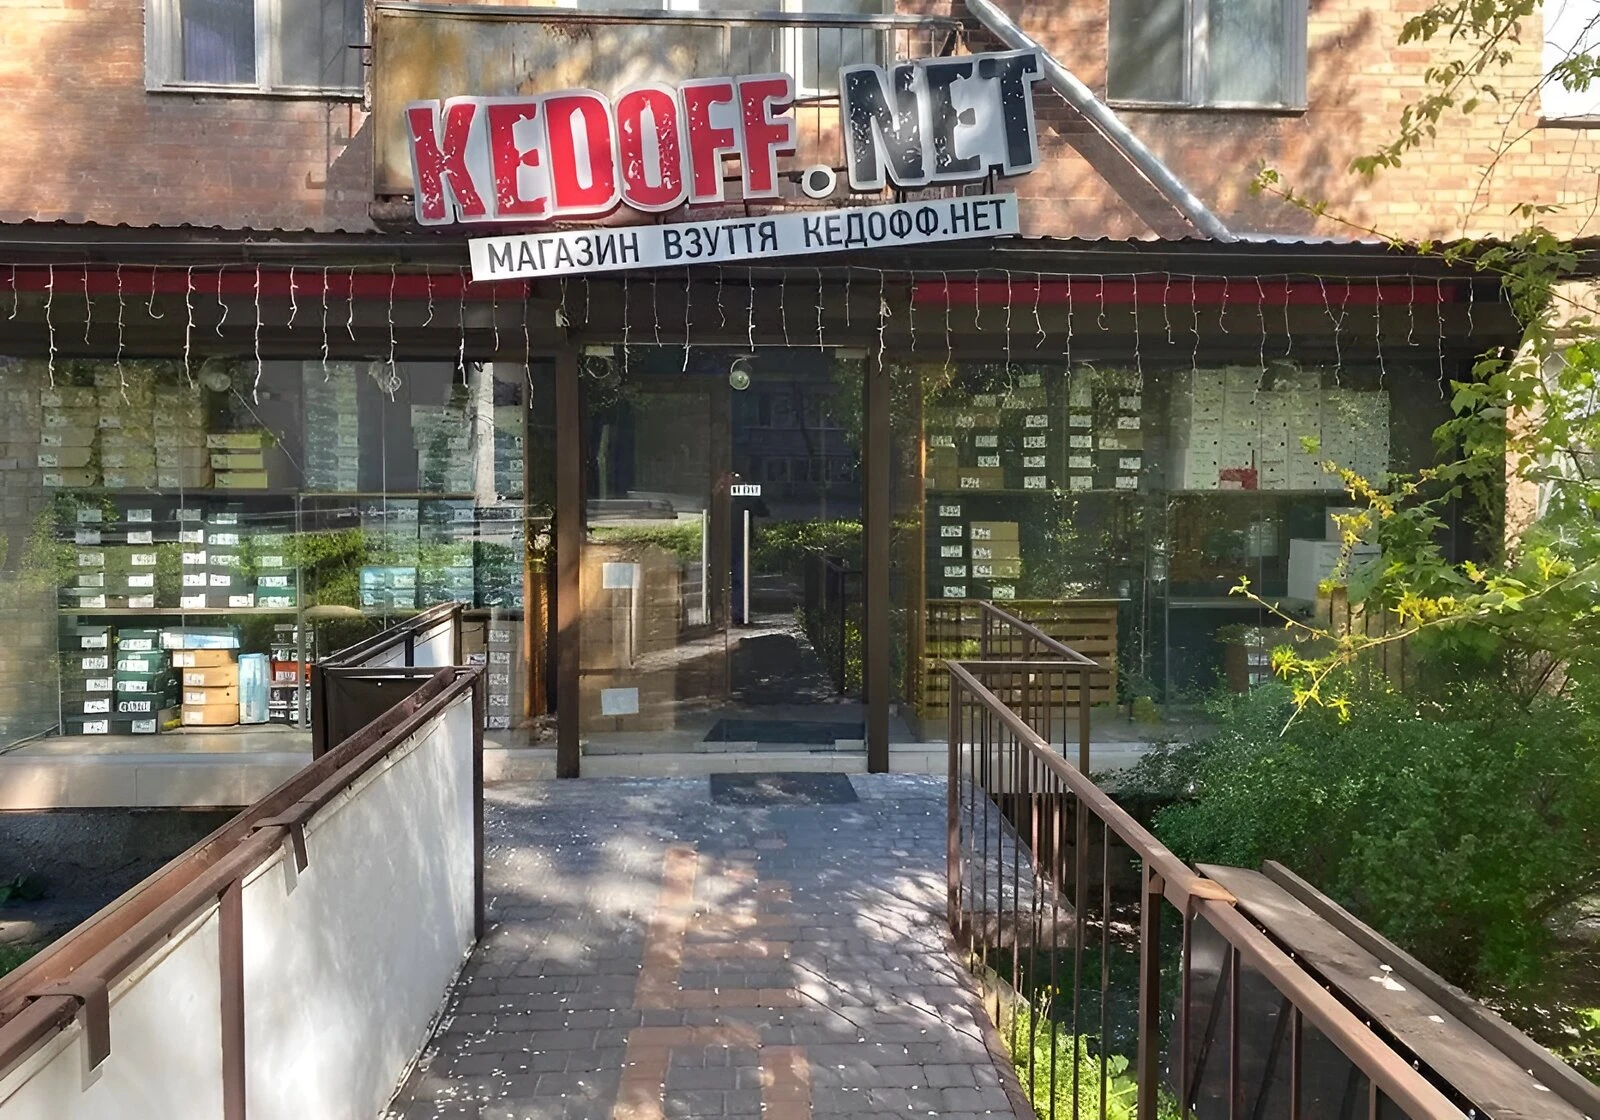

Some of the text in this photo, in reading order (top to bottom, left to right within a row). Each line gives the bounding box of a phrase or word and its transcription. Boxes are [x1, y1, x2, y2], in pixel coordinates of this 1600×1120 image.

[405, 51, 1043, 223] KEDOFF.NET
[487, 199, 1006, 274] МАГАЗИН ВЗУТТЯ КЕДОФФ.НЕТ
